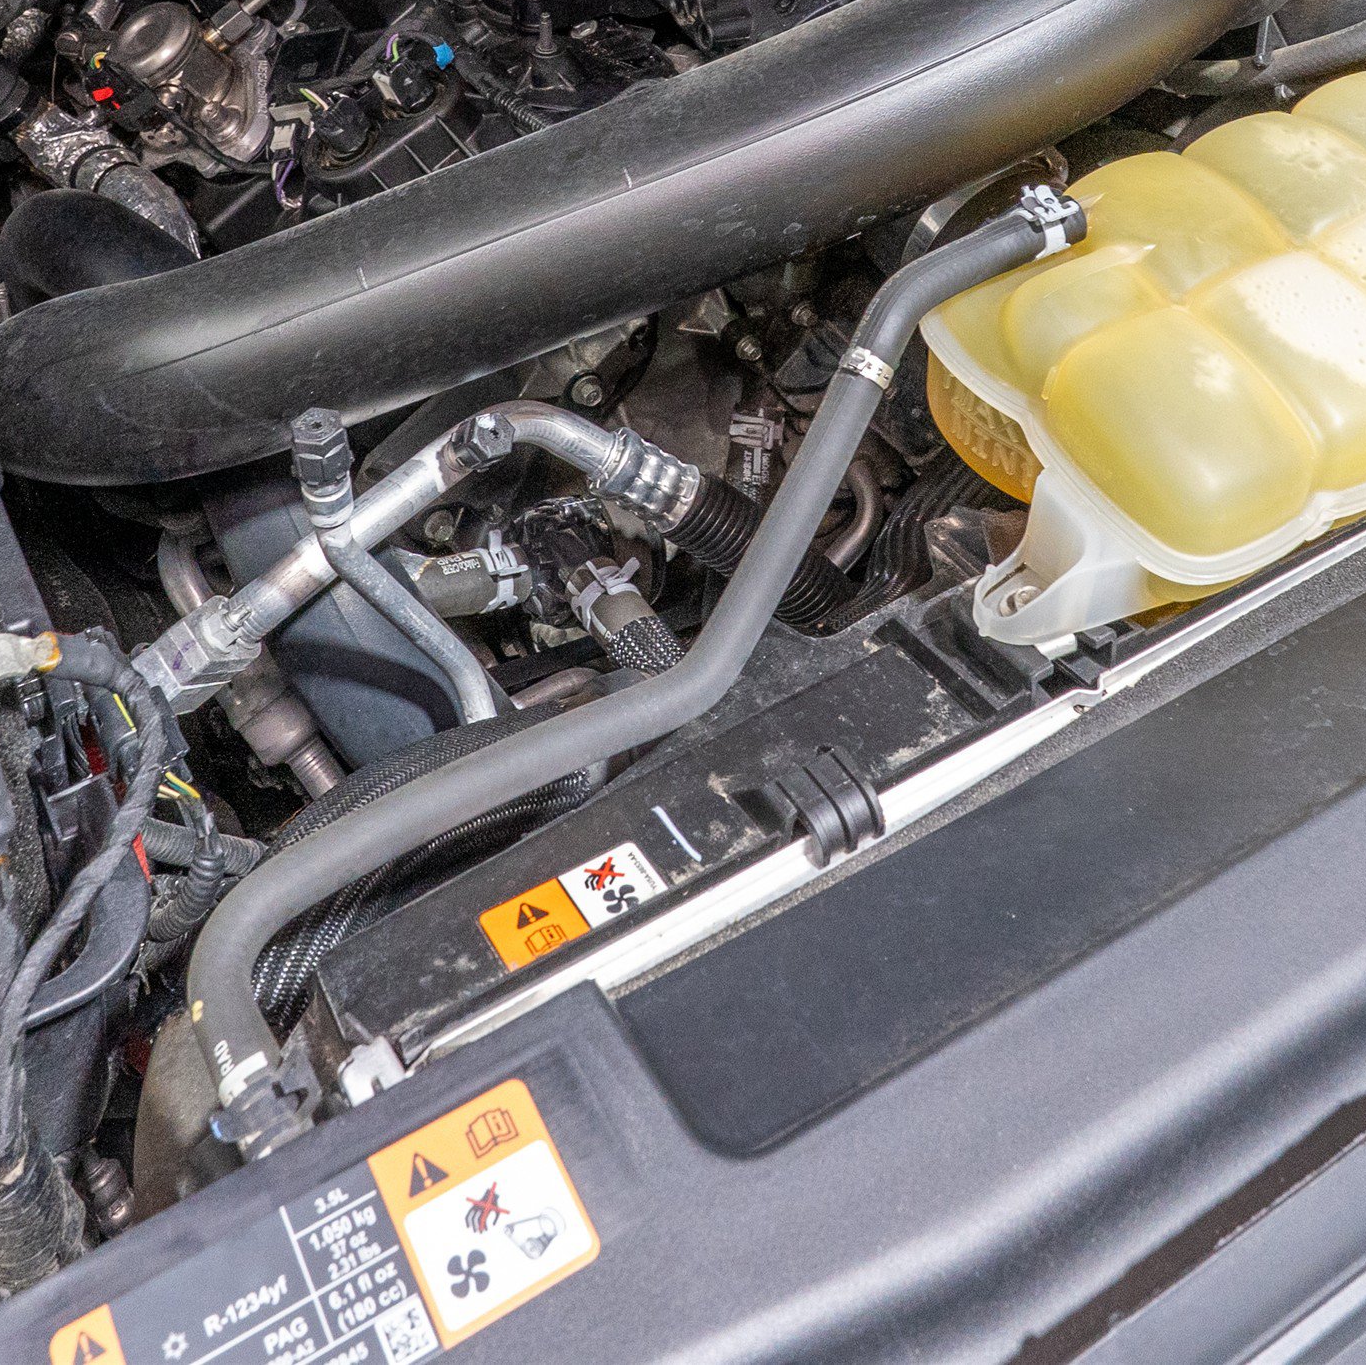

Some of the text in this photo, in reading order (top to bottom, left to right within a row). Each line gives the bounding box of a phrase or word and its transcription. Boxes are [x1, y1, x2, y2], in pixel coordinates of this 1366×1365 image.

[309, 1205, 377, 1251] 1.050 kg
[329, 1231, 368, 1260] 37 oz
[327, 1242, 382, 1280] 2.31 lbs
[203, 1274, 288, 1337] R-1234yf
[329, 1261, 398, 1310] 6.1 fl oz
[337, 1278, 407, 1334] (180 cc)
[263, 1316, 309, 1355] PAG
